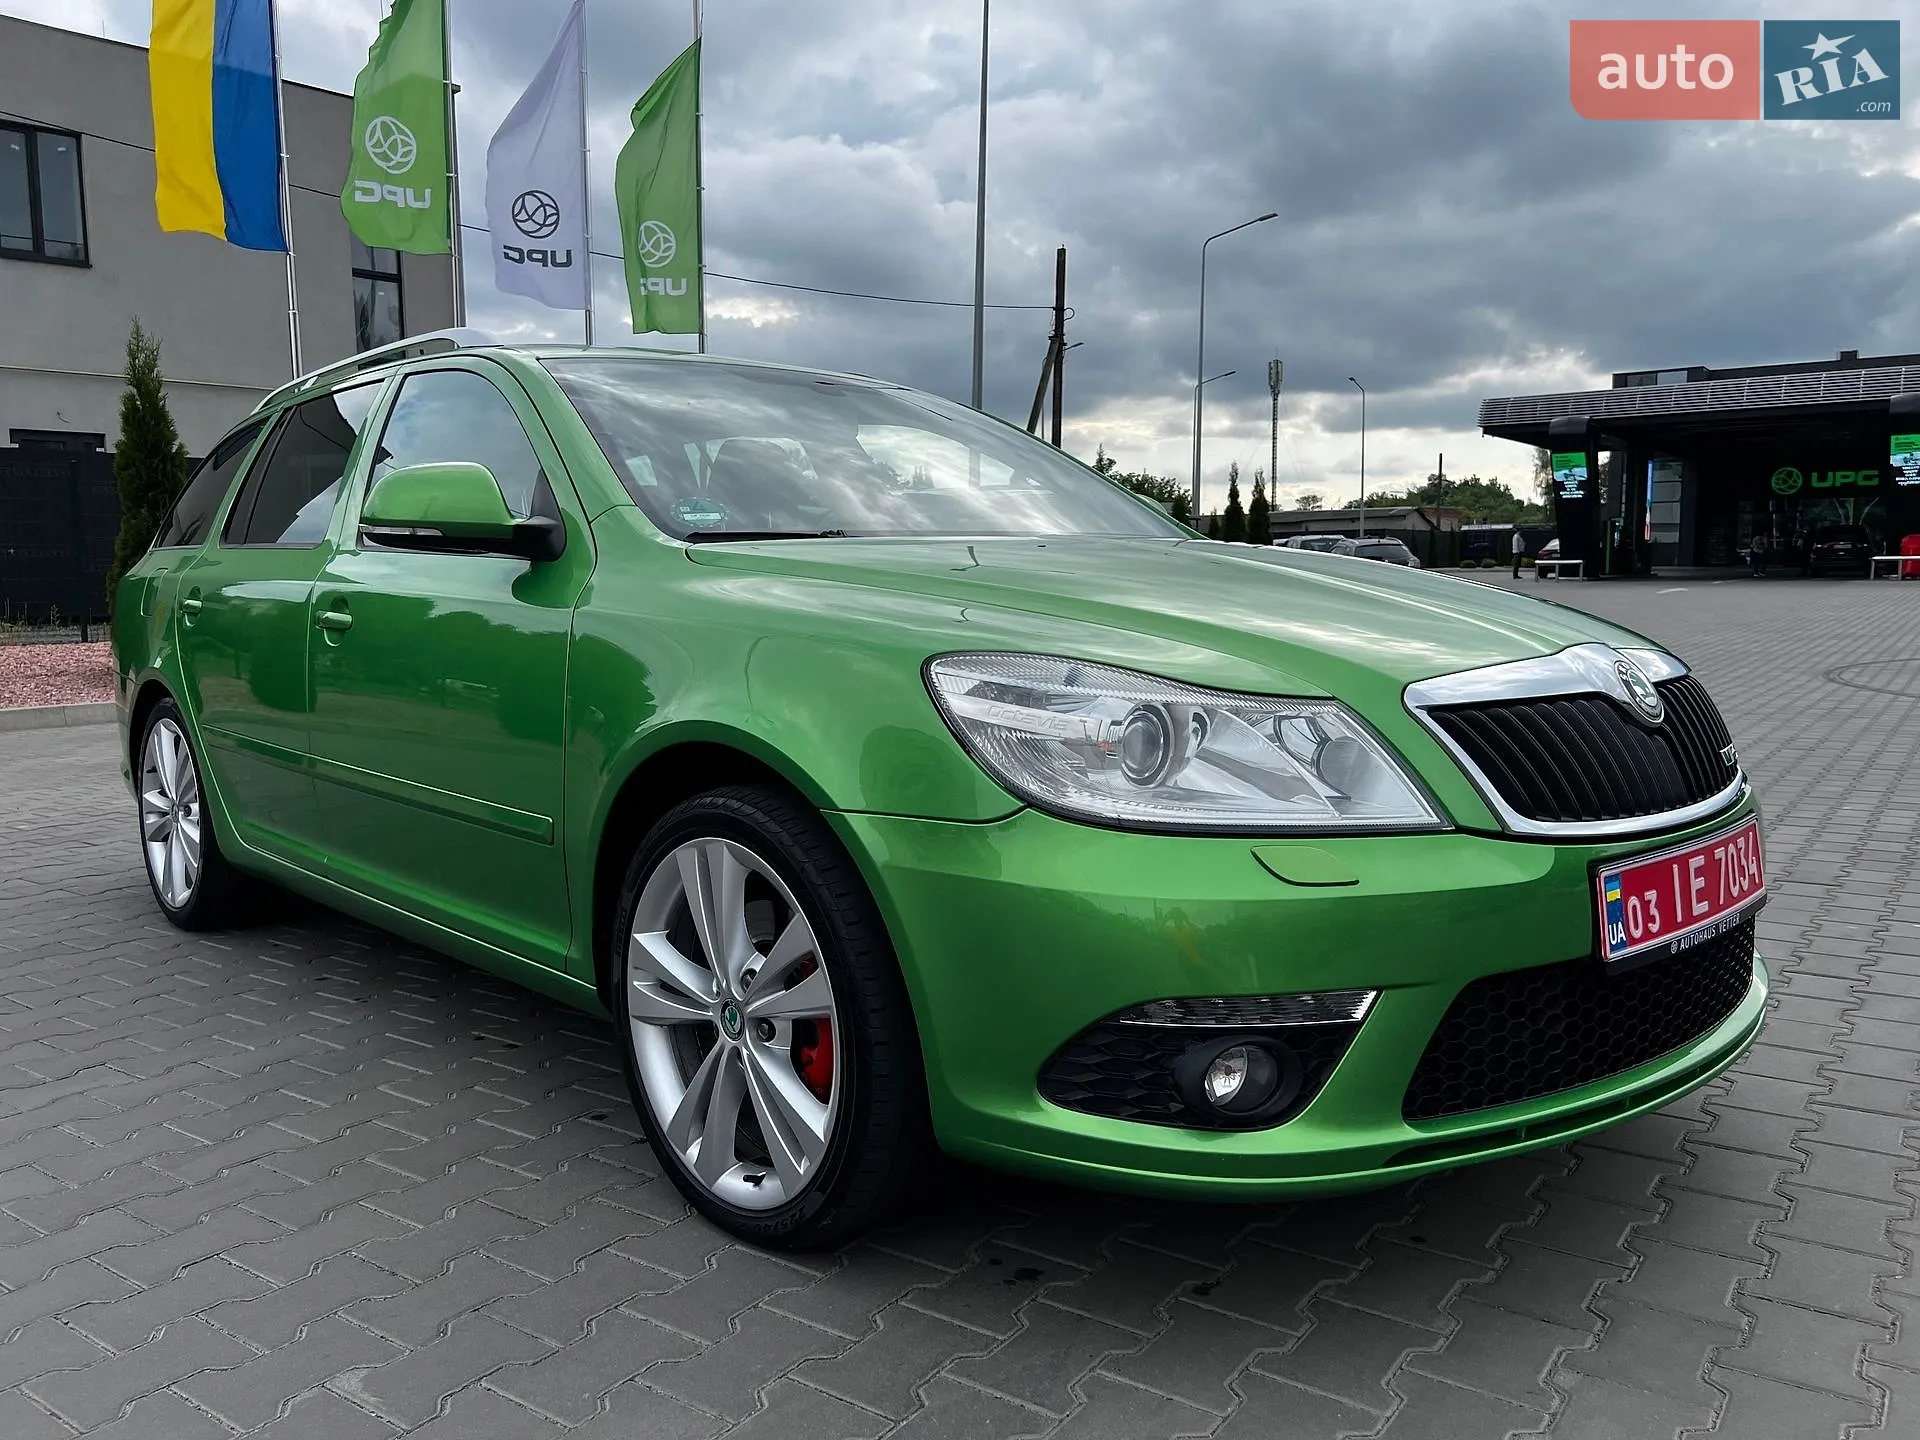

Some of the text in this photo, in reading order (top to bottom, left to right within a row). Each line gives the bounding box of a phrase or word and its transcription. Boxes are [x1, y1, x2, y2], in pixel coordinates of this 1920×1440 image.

[1811, 470, 1879, 487] UPG
[1627, 832, 1759, 939] 03 IE 7034
[1608, 921, 1627, 945] UA
[1679, 913, 1741, 950] AUTOHAUS VETTER
